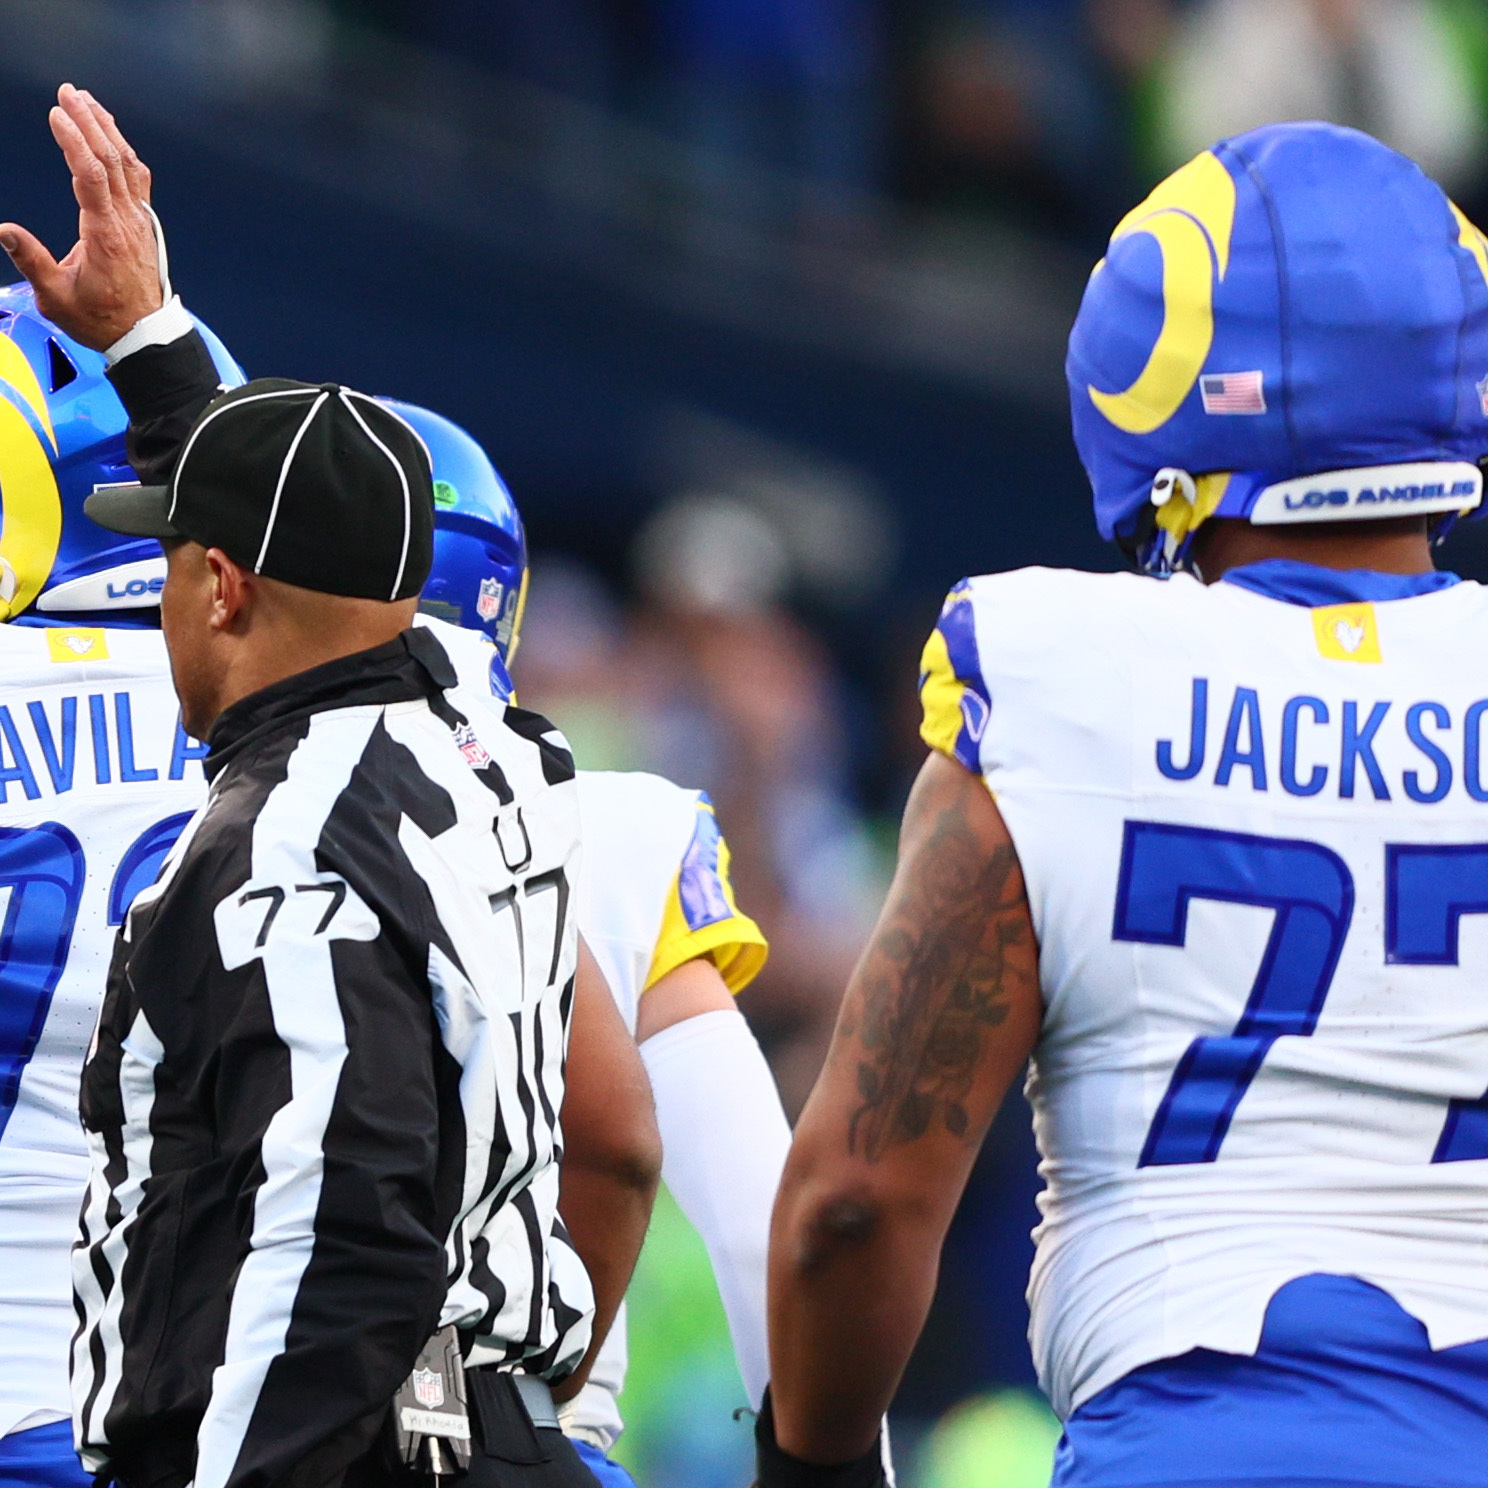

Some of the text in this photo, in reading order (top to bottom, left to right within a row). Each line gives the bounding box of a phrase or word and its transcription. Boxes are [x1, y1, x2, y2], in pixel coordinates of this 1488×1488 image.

[1284, 490, 1350, 511] LOS
[107, 577, 165, 598] LOS
[237, 881, 347, 949] 77
[418, 1383, 441, 1402] NFL
